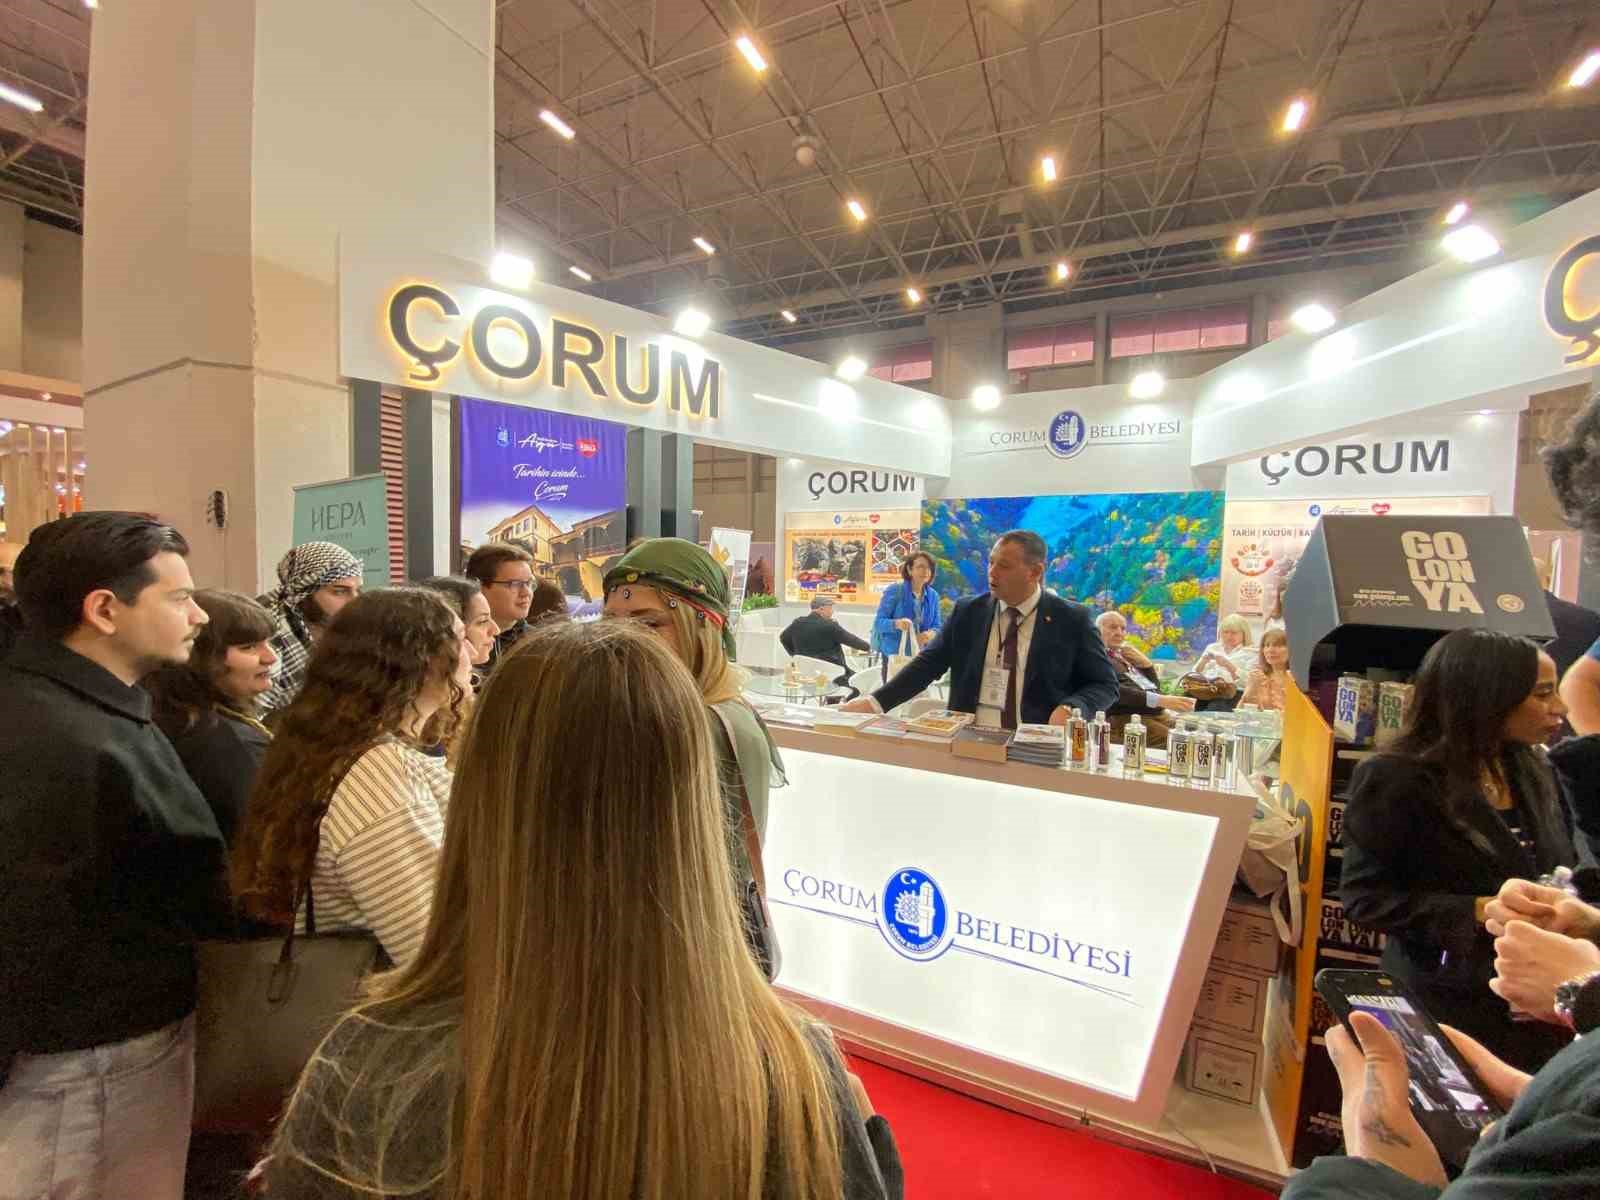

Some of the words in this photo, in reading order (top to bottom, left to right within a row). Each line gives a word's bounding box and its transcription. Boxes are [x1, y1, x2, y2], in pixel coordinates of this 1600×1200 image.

[388, 283, 721, 419] ÇORUM
[1260, 439, 1450, 486] ÇORUM
[808, 470, 915, 501] ÇORUM
[311, 500, 367, 532] HEPA
[1401, 530, 1468, 561] GO
[1406, 559, 1477, 583] LON
[1412, 580, 1484, 614] YA
[783, 868, 878, 914] ÇORUM
[955, 910, 1133, 979] BELEDİYESİ
